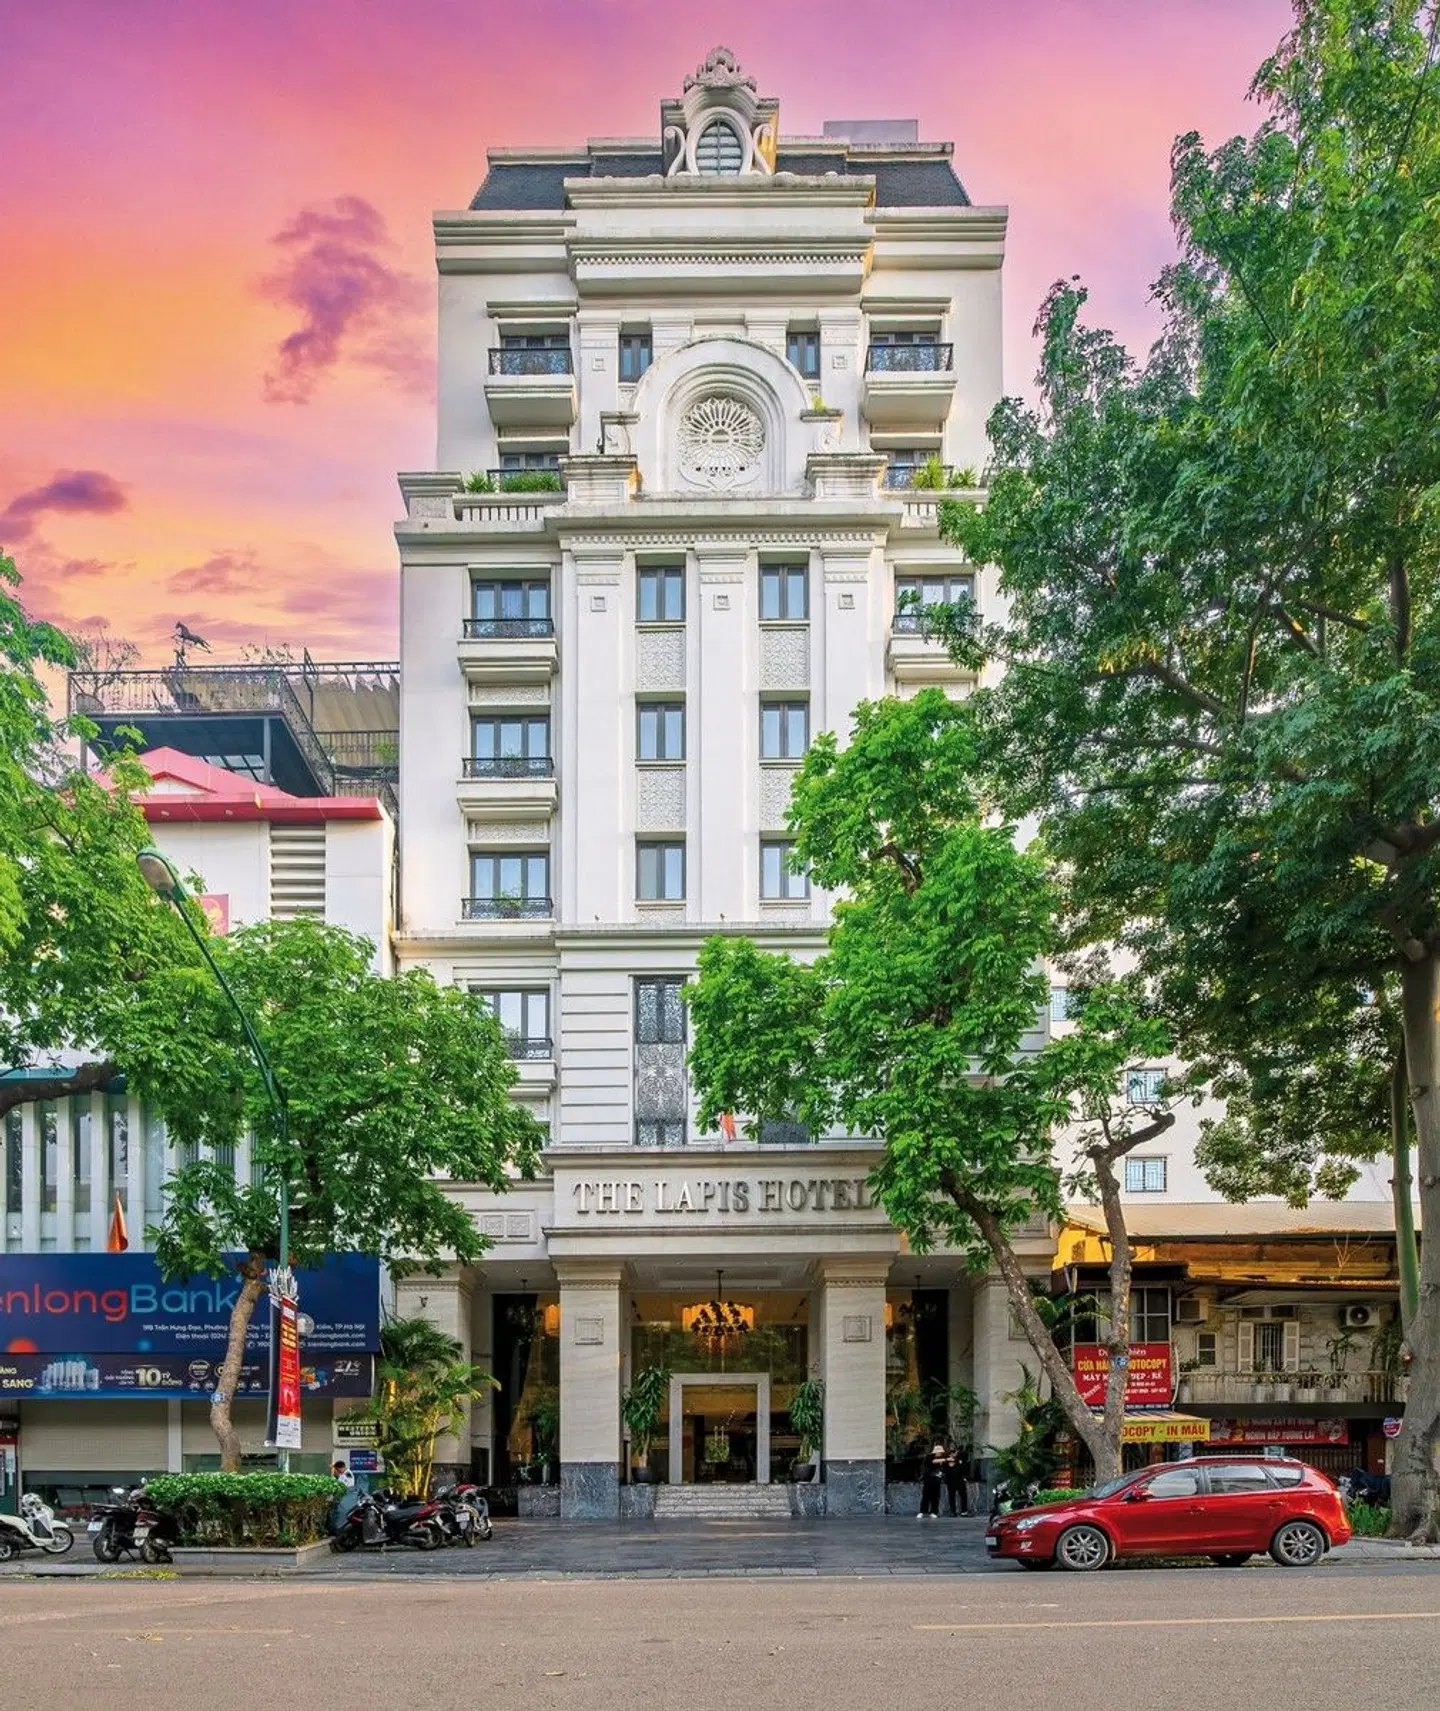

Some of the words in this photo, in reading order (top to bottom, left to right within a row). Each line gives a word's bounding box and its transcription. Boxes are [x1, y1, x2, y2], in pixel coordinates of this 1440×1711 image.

[573, 1182, 645, 1214] THE
[655, 1180, 749, 1213] LAPIS
[757, 1178, 873, 1212] HOTEL
[0, 1284, 238, 1321] nlongBank
[136, 1367, 161, 1387] 10
[1166, 1426, 1177, 1436] IN
